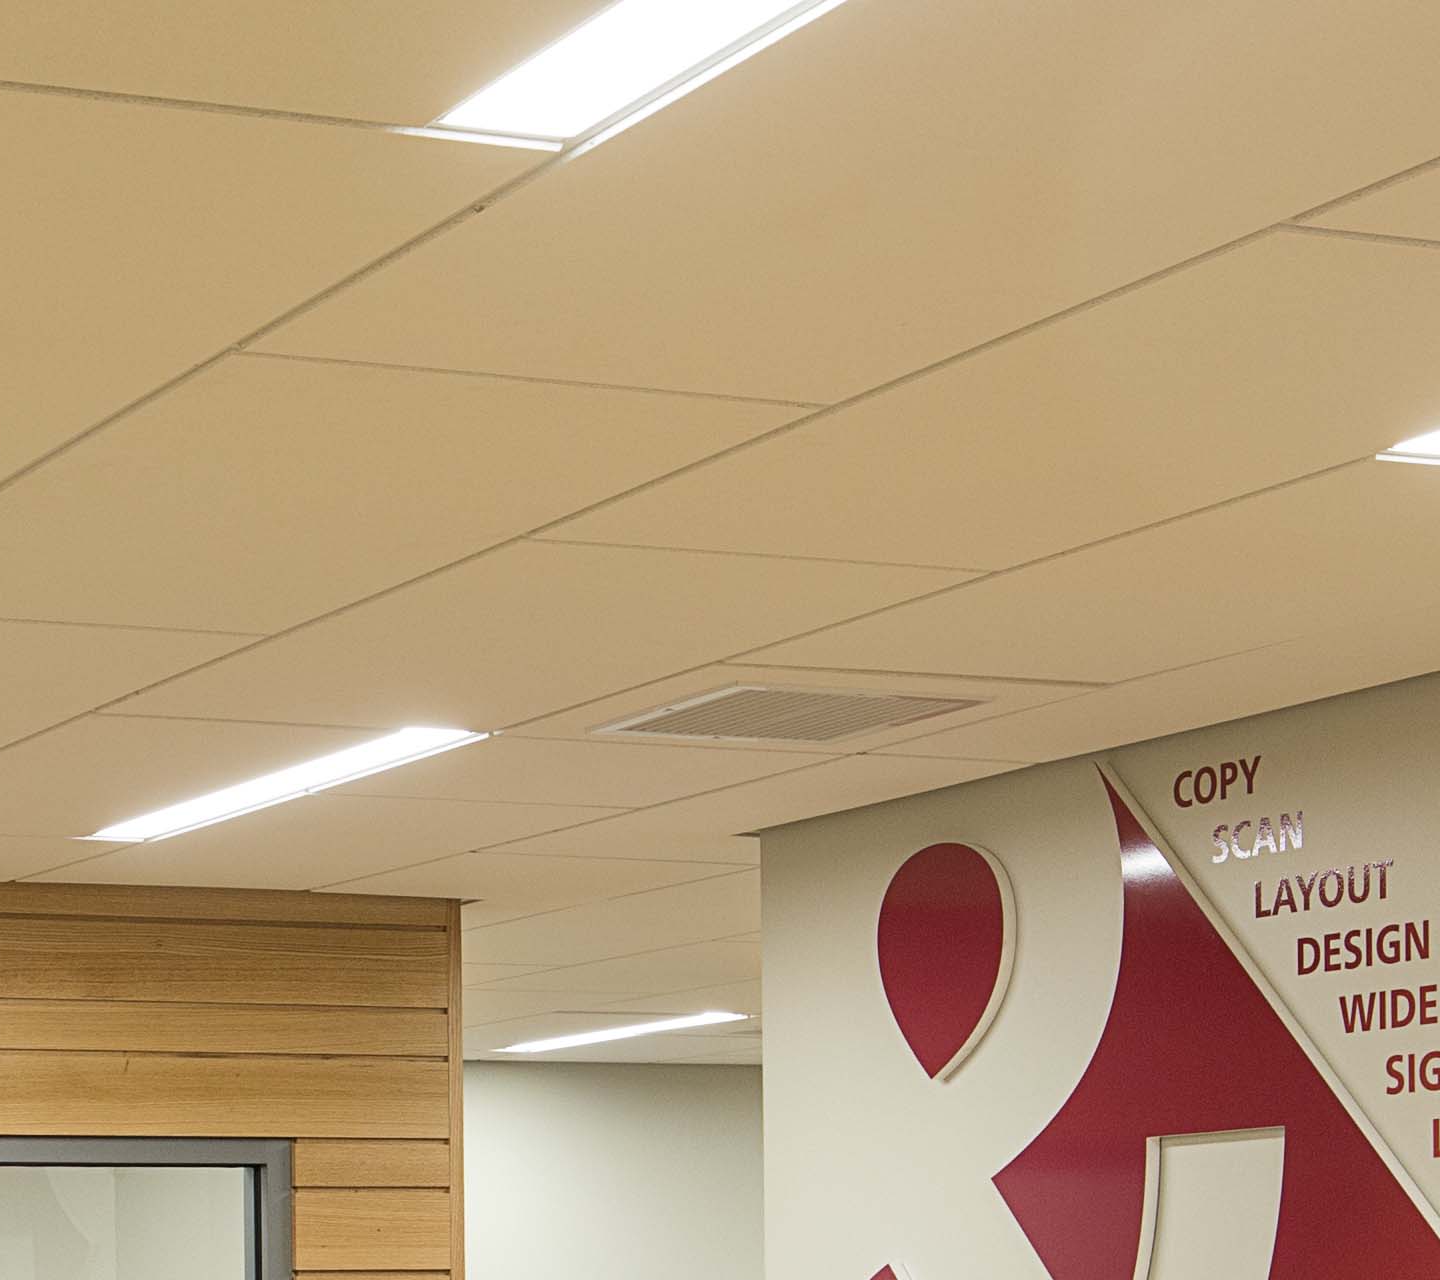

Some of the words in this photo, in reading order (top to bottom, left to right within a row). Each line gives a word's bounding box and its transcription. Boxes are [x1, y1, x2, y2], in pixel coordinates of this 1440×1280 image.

[1173, 754, 1262, 809] COPY
[1211, 809, 1304, 864] SCAN
[1254, 859, 1395, 919] LAYOUT
[1296, 918, 1431, 977] DESIGN
[1338, 983, 1439, 1035] WIDE
